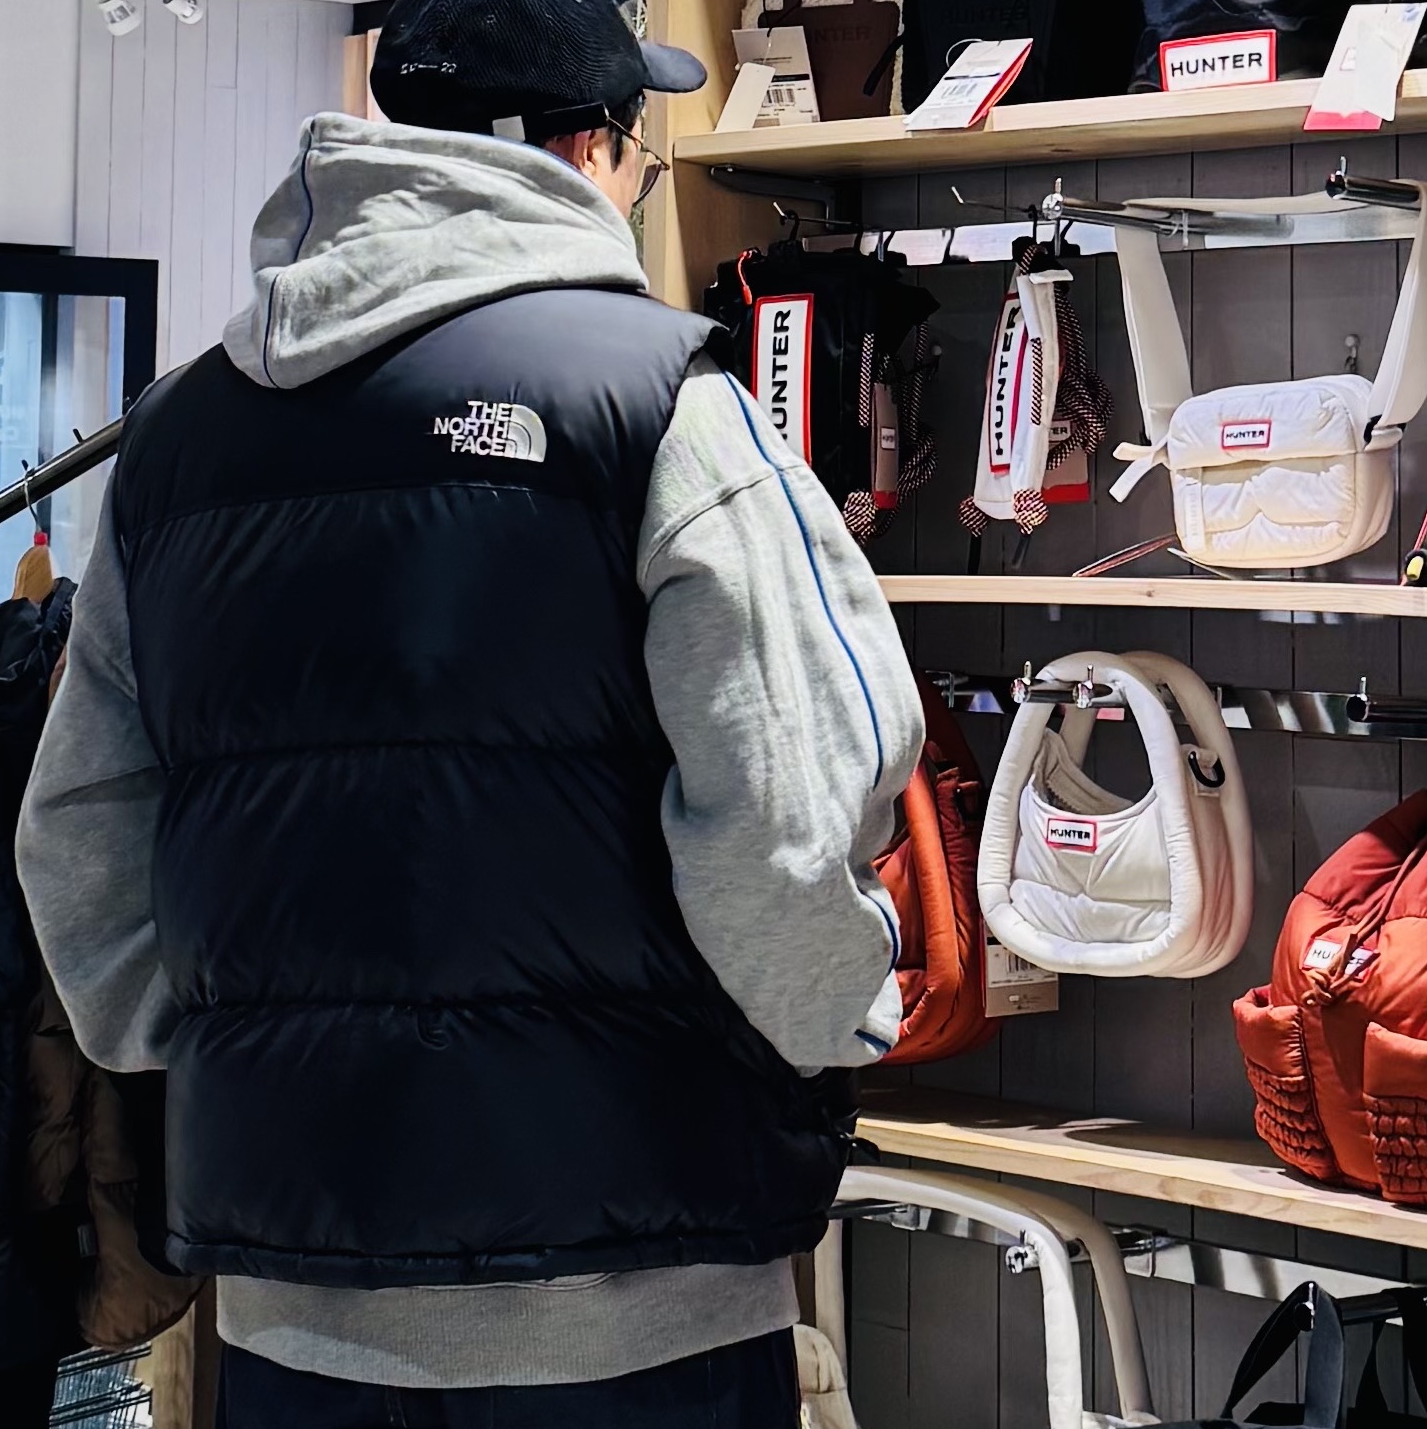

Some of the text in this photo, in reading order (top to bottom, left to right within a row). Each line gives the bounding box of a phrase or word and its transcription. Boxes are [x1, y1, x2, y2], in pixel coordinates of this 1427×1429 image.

[1171, 50, 1263, 78] HUNTER
[993, 305, 1021, 456] HUNTER
[467, 400, 512, 422] THE
[433, 417, 509, 439] NORTH
[1226, 429, 1266, 443] HUNTER
[451, 435, 506, 456] FACE
[1049, 827, 1090, 841] HUNTER
